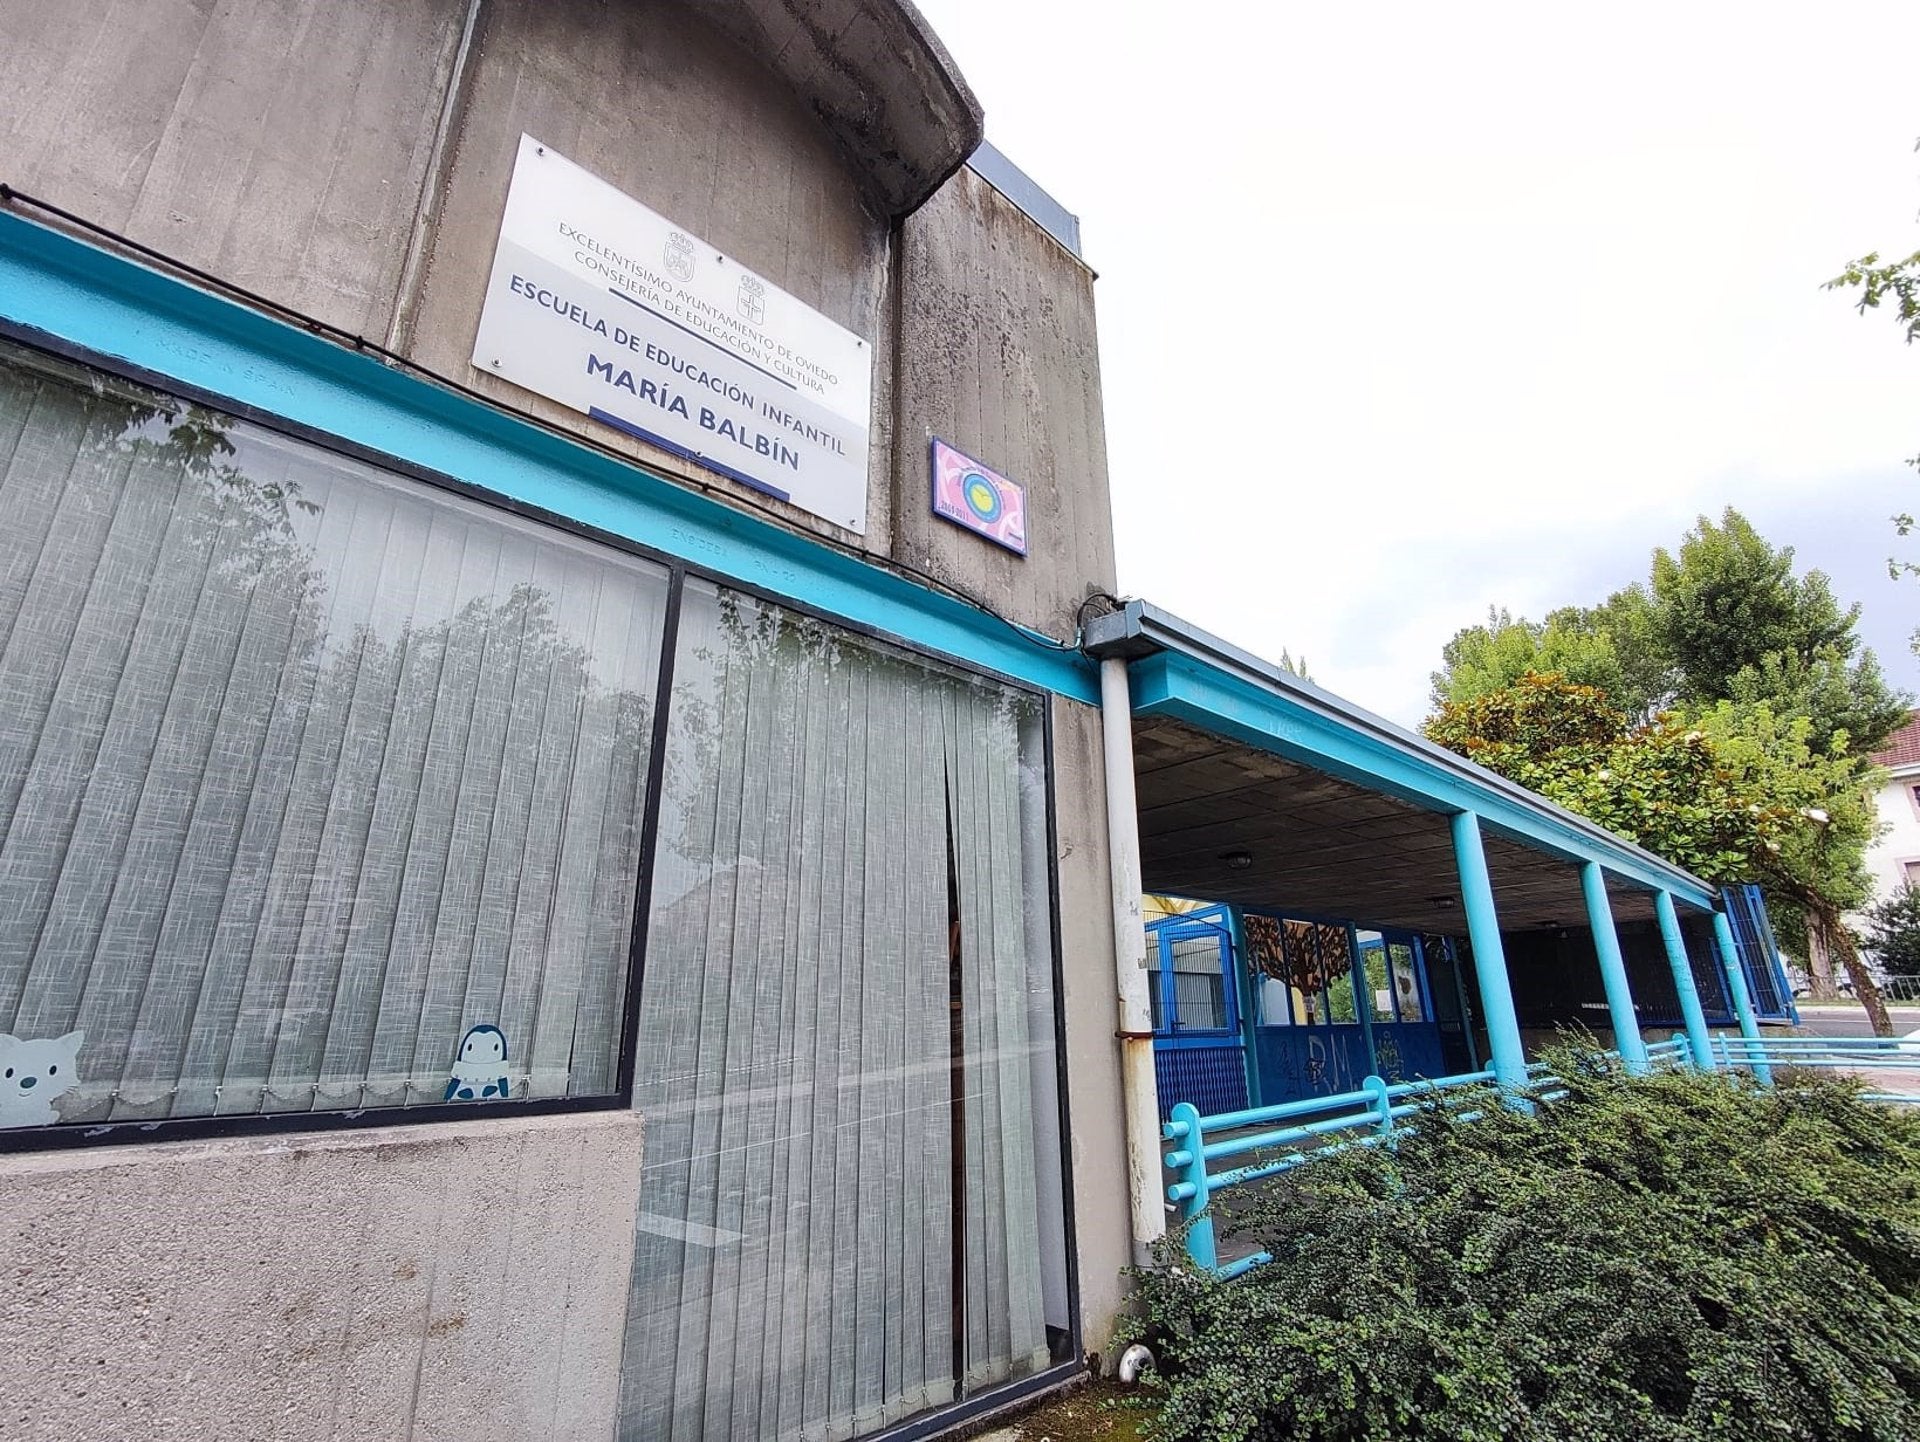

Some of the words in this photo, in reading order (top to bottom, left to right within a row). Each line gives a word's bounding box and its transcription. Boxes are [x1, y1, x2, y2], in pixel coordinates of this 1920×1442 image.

[510, 274, 607, 338] ESCUELA
[614, 327, 640, 353] DE
[645, 343, 754, 410] EDUCACIÓN
[763, 402, 846, 456] INFANTIL
[559, 222, 673, 293] EXCELENTÍSIMO
[676, 290, 774, 350] AYUNTAMIENTO
[777, 345, 793, 361] DE
[795, 356, 838, 385] OVIEDO
[575, 251, 660, 305] CONSEJERÍA
[664, 299, 682, 317] DE
[686, 311, 760, 358] EDUCACIÓN
[764, 353, 772, 365] Y
[774, 360, 824, 395] CULTURA
[587, 353, 689, 420] MARÍA
[699, 407, 799, 471] BALBÍN
